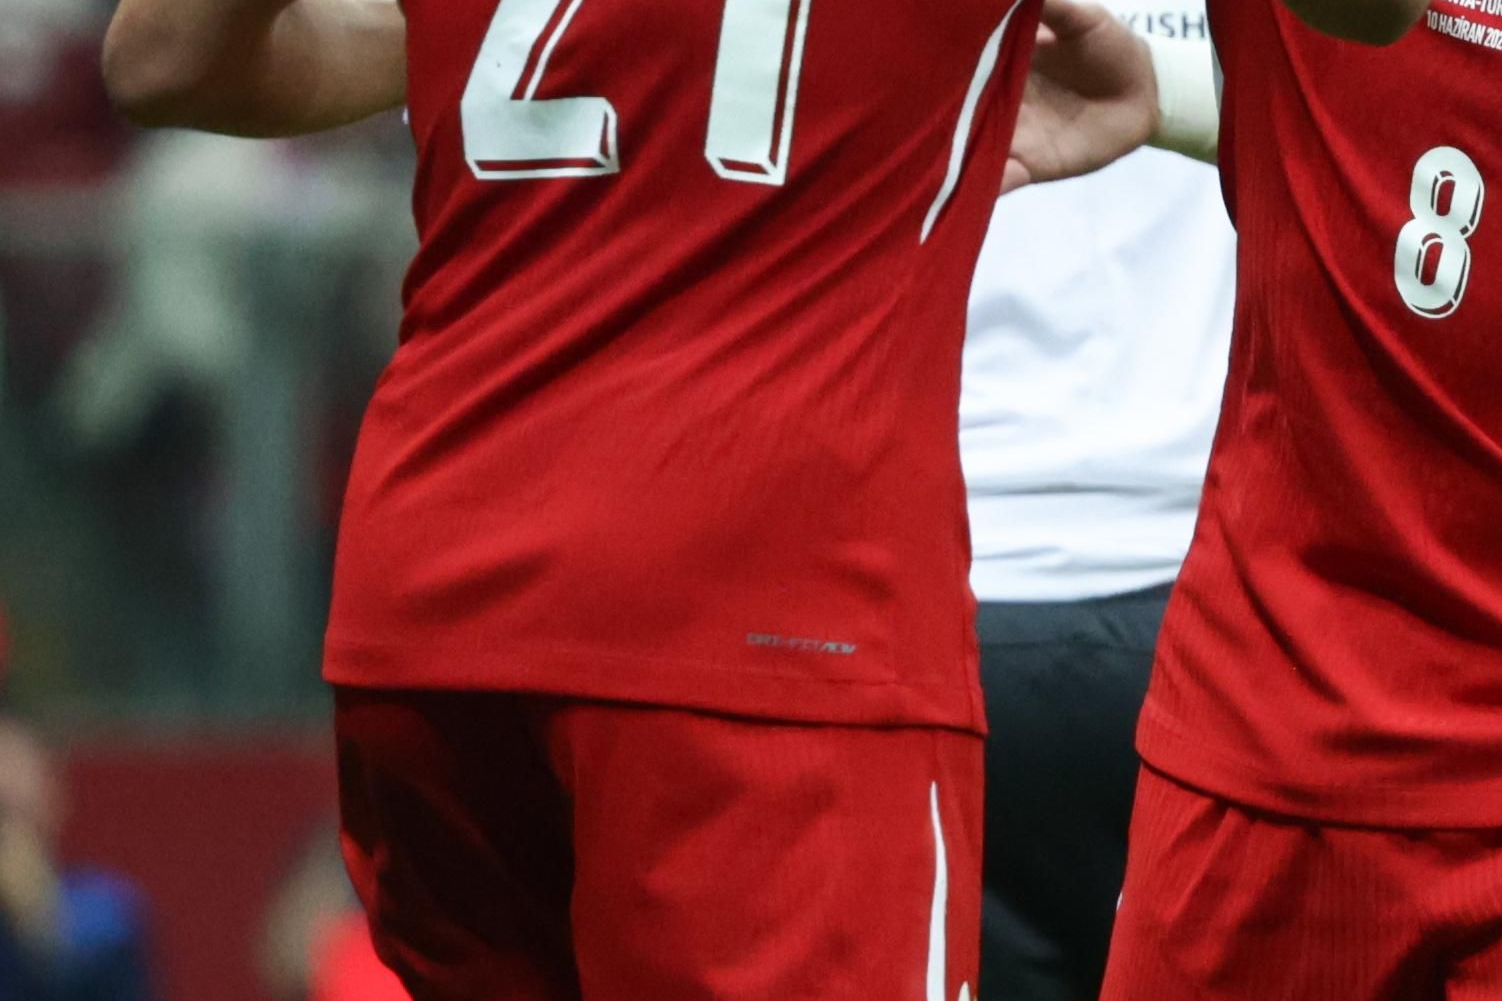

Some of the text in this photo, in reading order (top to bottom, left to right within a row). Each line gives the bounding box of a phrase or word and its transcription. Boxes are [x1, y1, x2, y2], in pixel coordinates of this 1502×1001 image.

[1426, 9, 1438, 31] 10
[1438, 14, 1487, 46] HAZİRAN
[1394, 145, 1485, 319] 8
